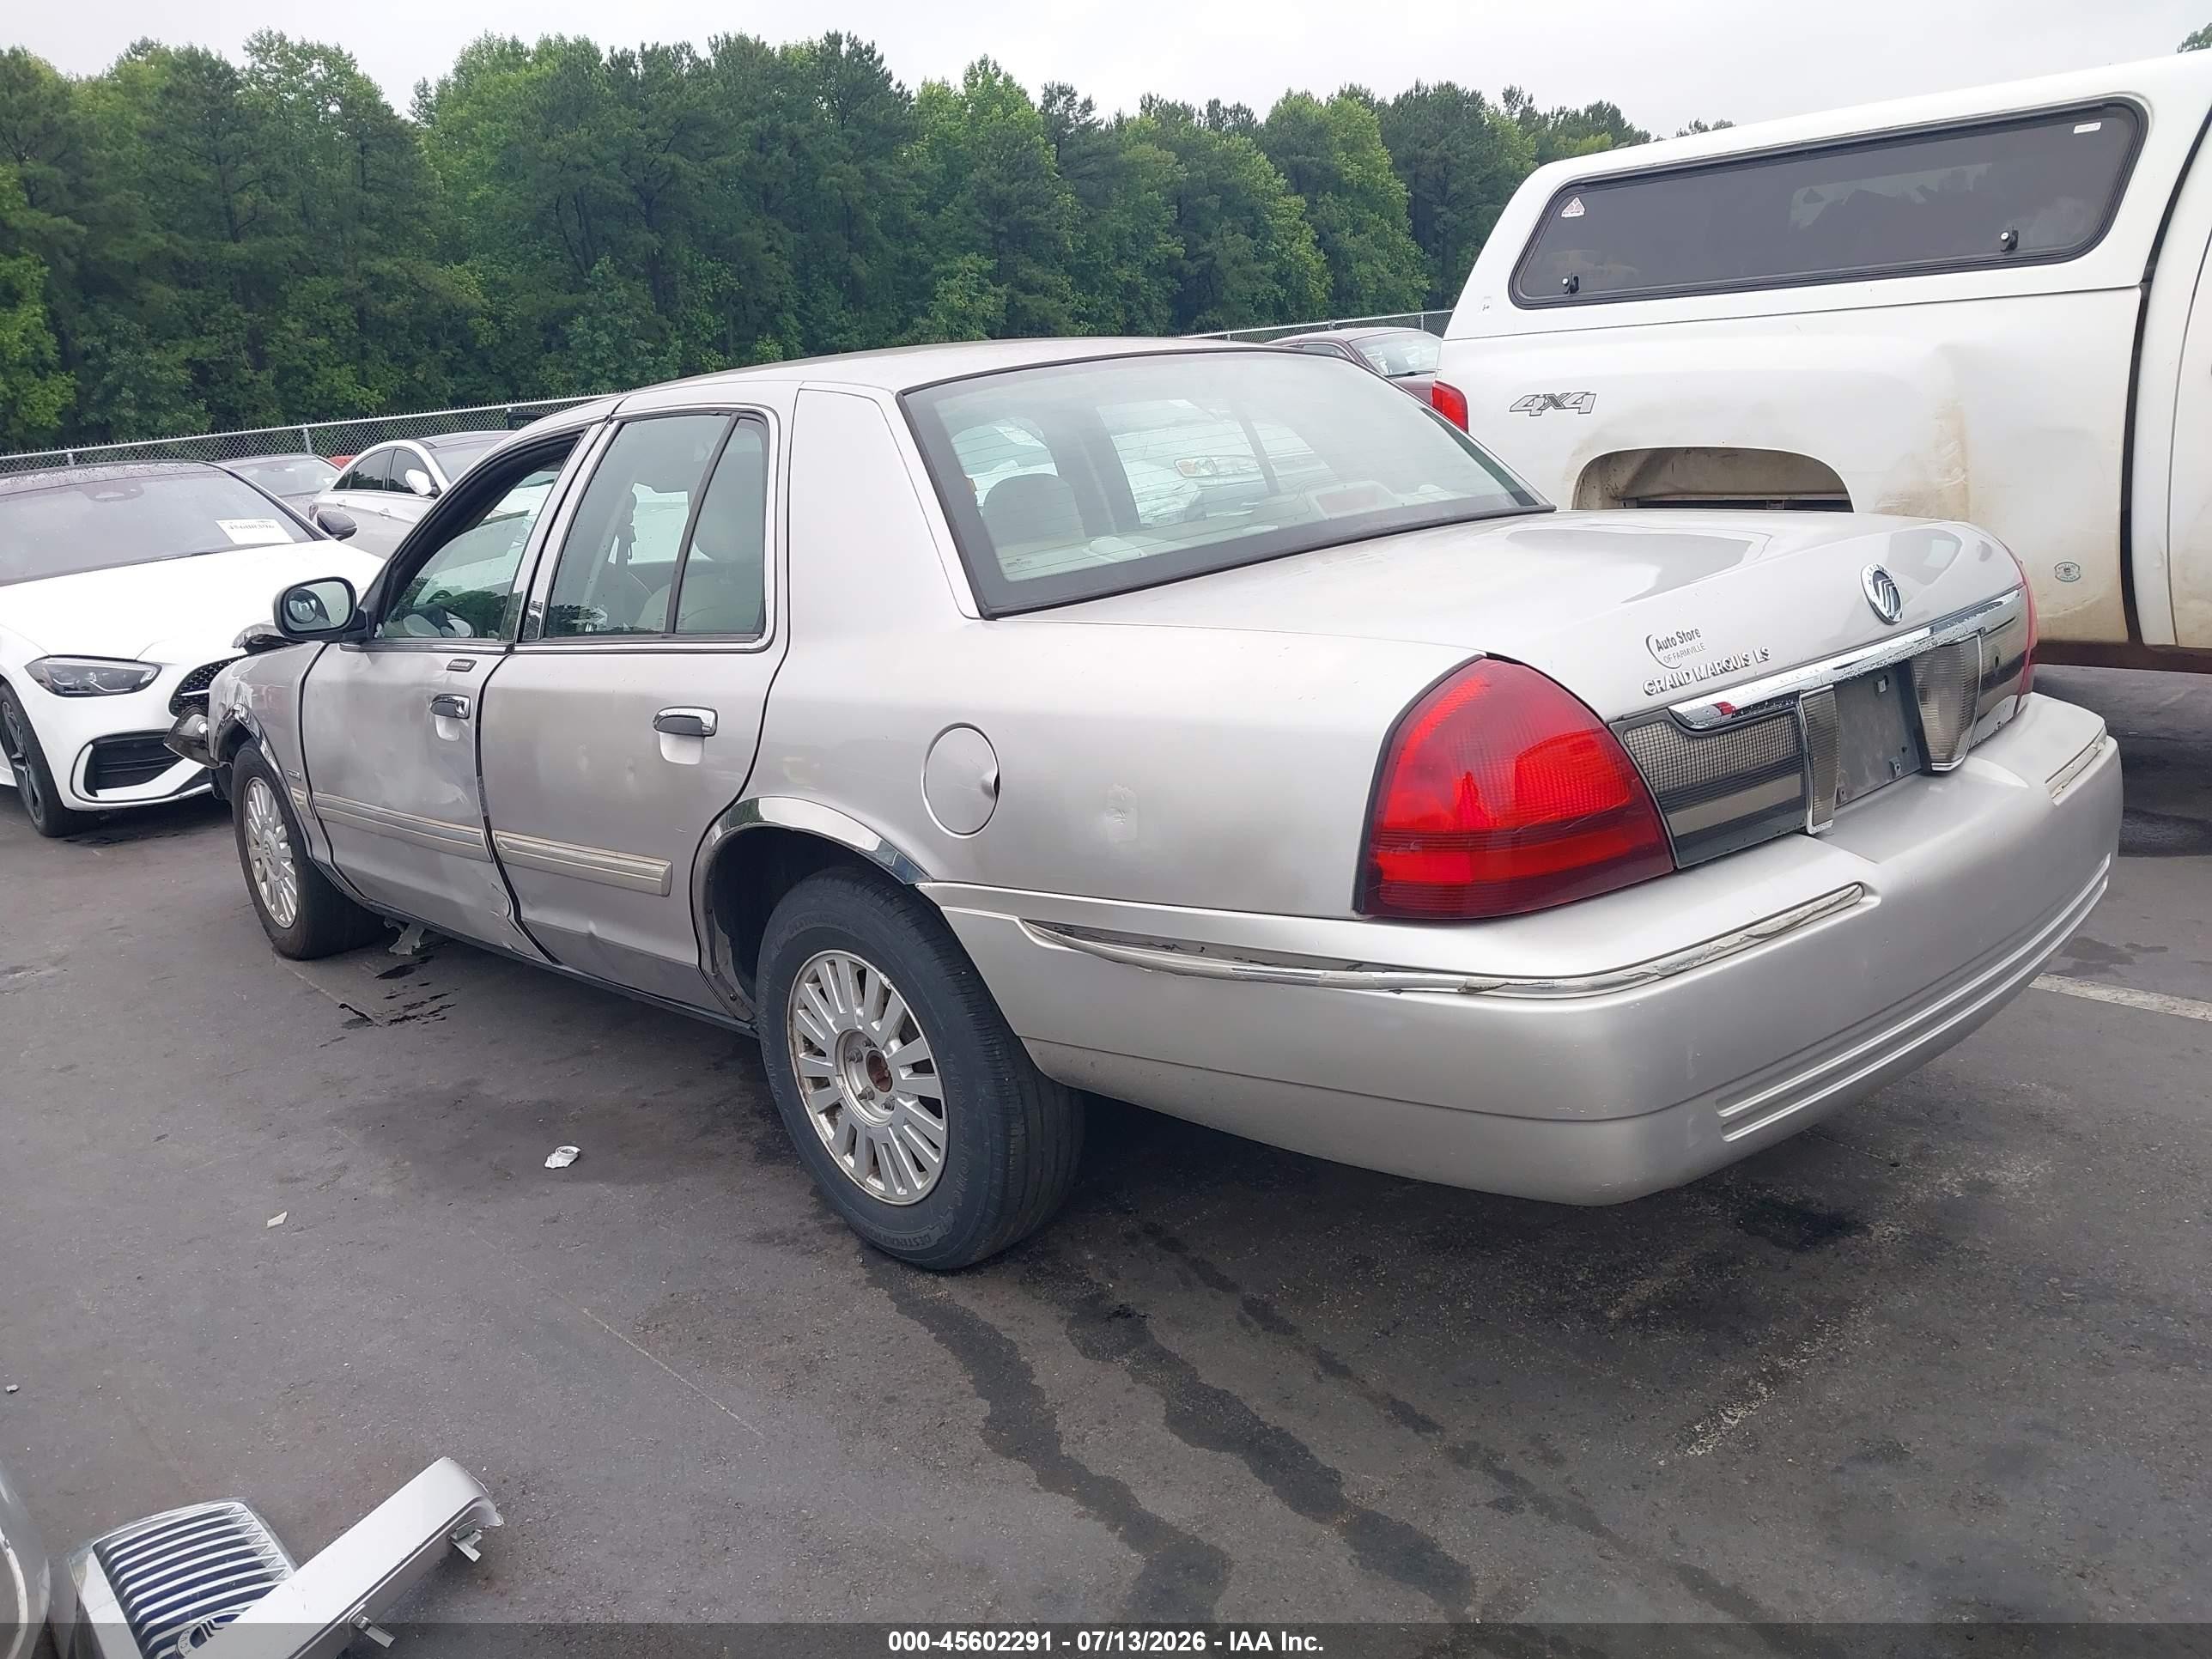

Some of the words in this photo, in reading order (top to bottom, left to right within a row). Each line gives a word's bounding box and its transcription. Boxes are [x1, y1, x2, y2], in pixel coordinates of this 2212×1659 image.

[1509, 391, 1597, 417] 4x4
[1655, 636, 1678, 653] Auto
[1675, 628, 1702, 645] Store
[1643, 669, 1693, 696] GRAND
[1692, 651, 1752, 682] MARQUIS
[1753, 645, 1771, 664] LS
[1662, 653, 1673, 664] OF
